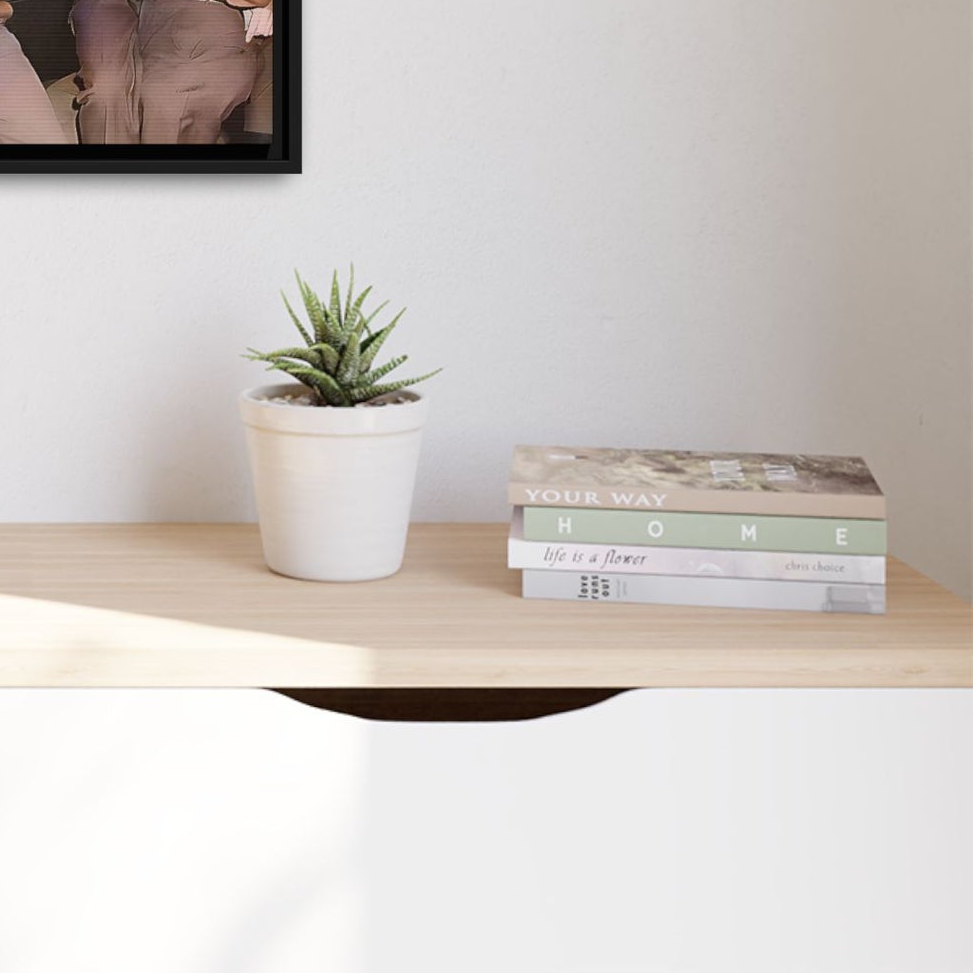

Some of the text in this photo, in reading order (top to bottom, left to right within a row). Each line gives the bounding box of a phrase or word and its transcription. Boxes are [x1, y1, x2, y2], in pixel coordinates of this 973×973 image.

[525, 489, 667, 506] YOUR WAY
[543, 546, 648, 569] life is a flower
[785, 559, 846, 573] chris choice
[578, 575, 589, 598] love
[591, 575, 599, 600] runs
[601, 578, 610, 597] out
